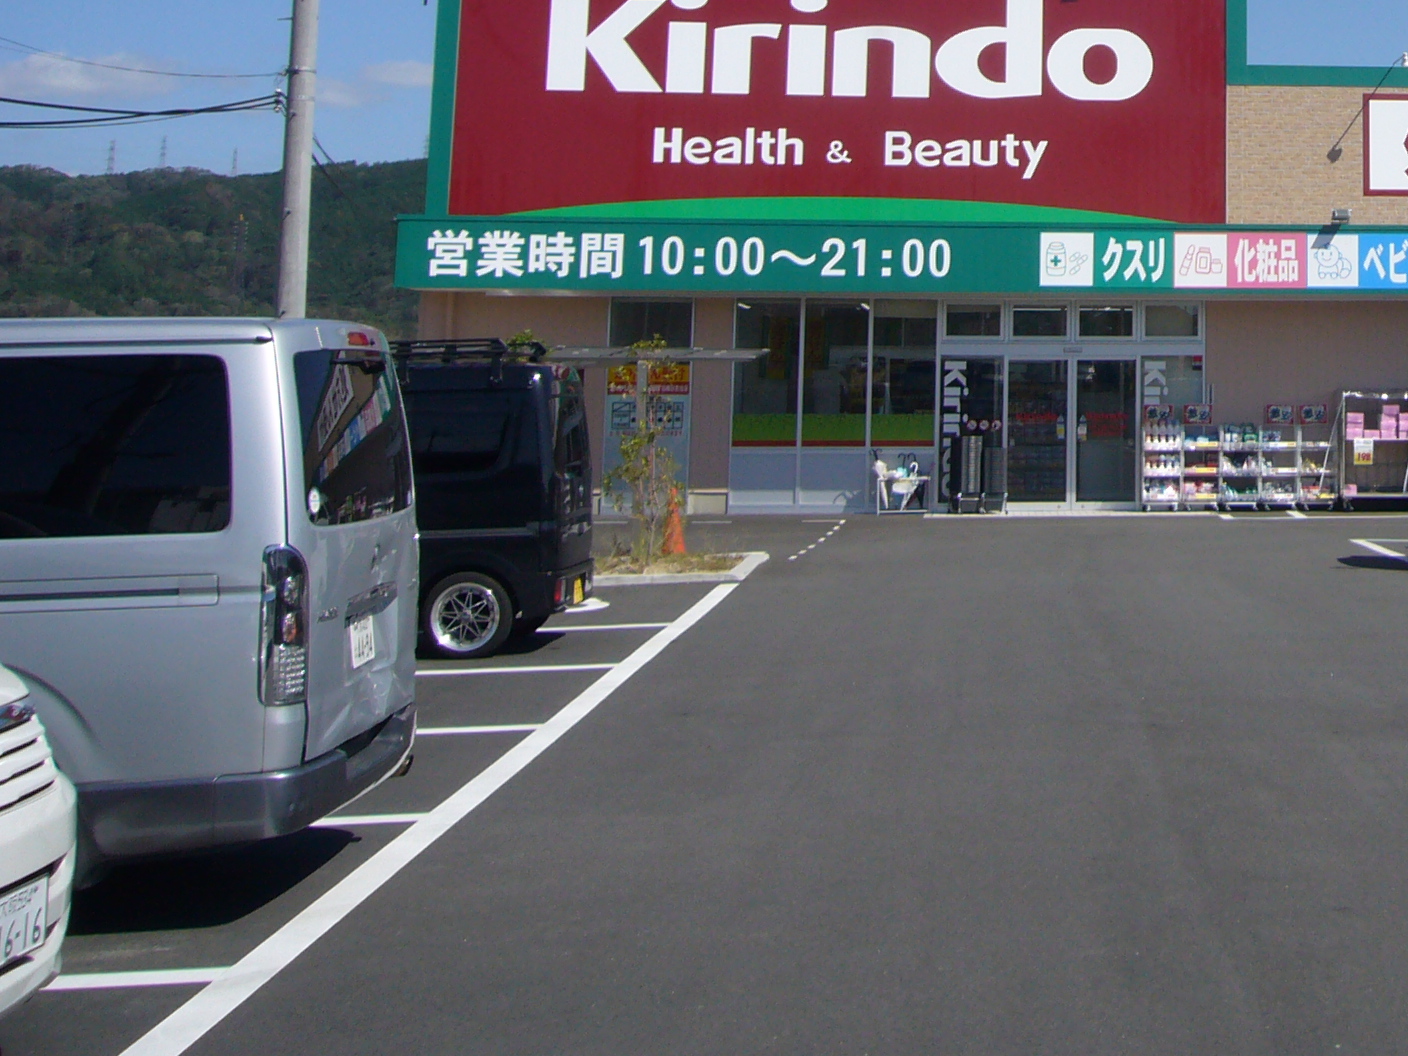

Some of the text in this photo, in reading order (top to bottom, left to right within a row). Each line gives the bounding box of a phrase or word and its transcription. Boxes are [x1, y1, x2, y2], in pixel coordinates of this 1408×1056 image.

[652, 127, 1049, 180] Health & Beauty
[426, 229, 625, 279] 営業時間
[1101, 237, 1166, 284] クスリ
[1234, 237, 1299, 285] 化粧品
